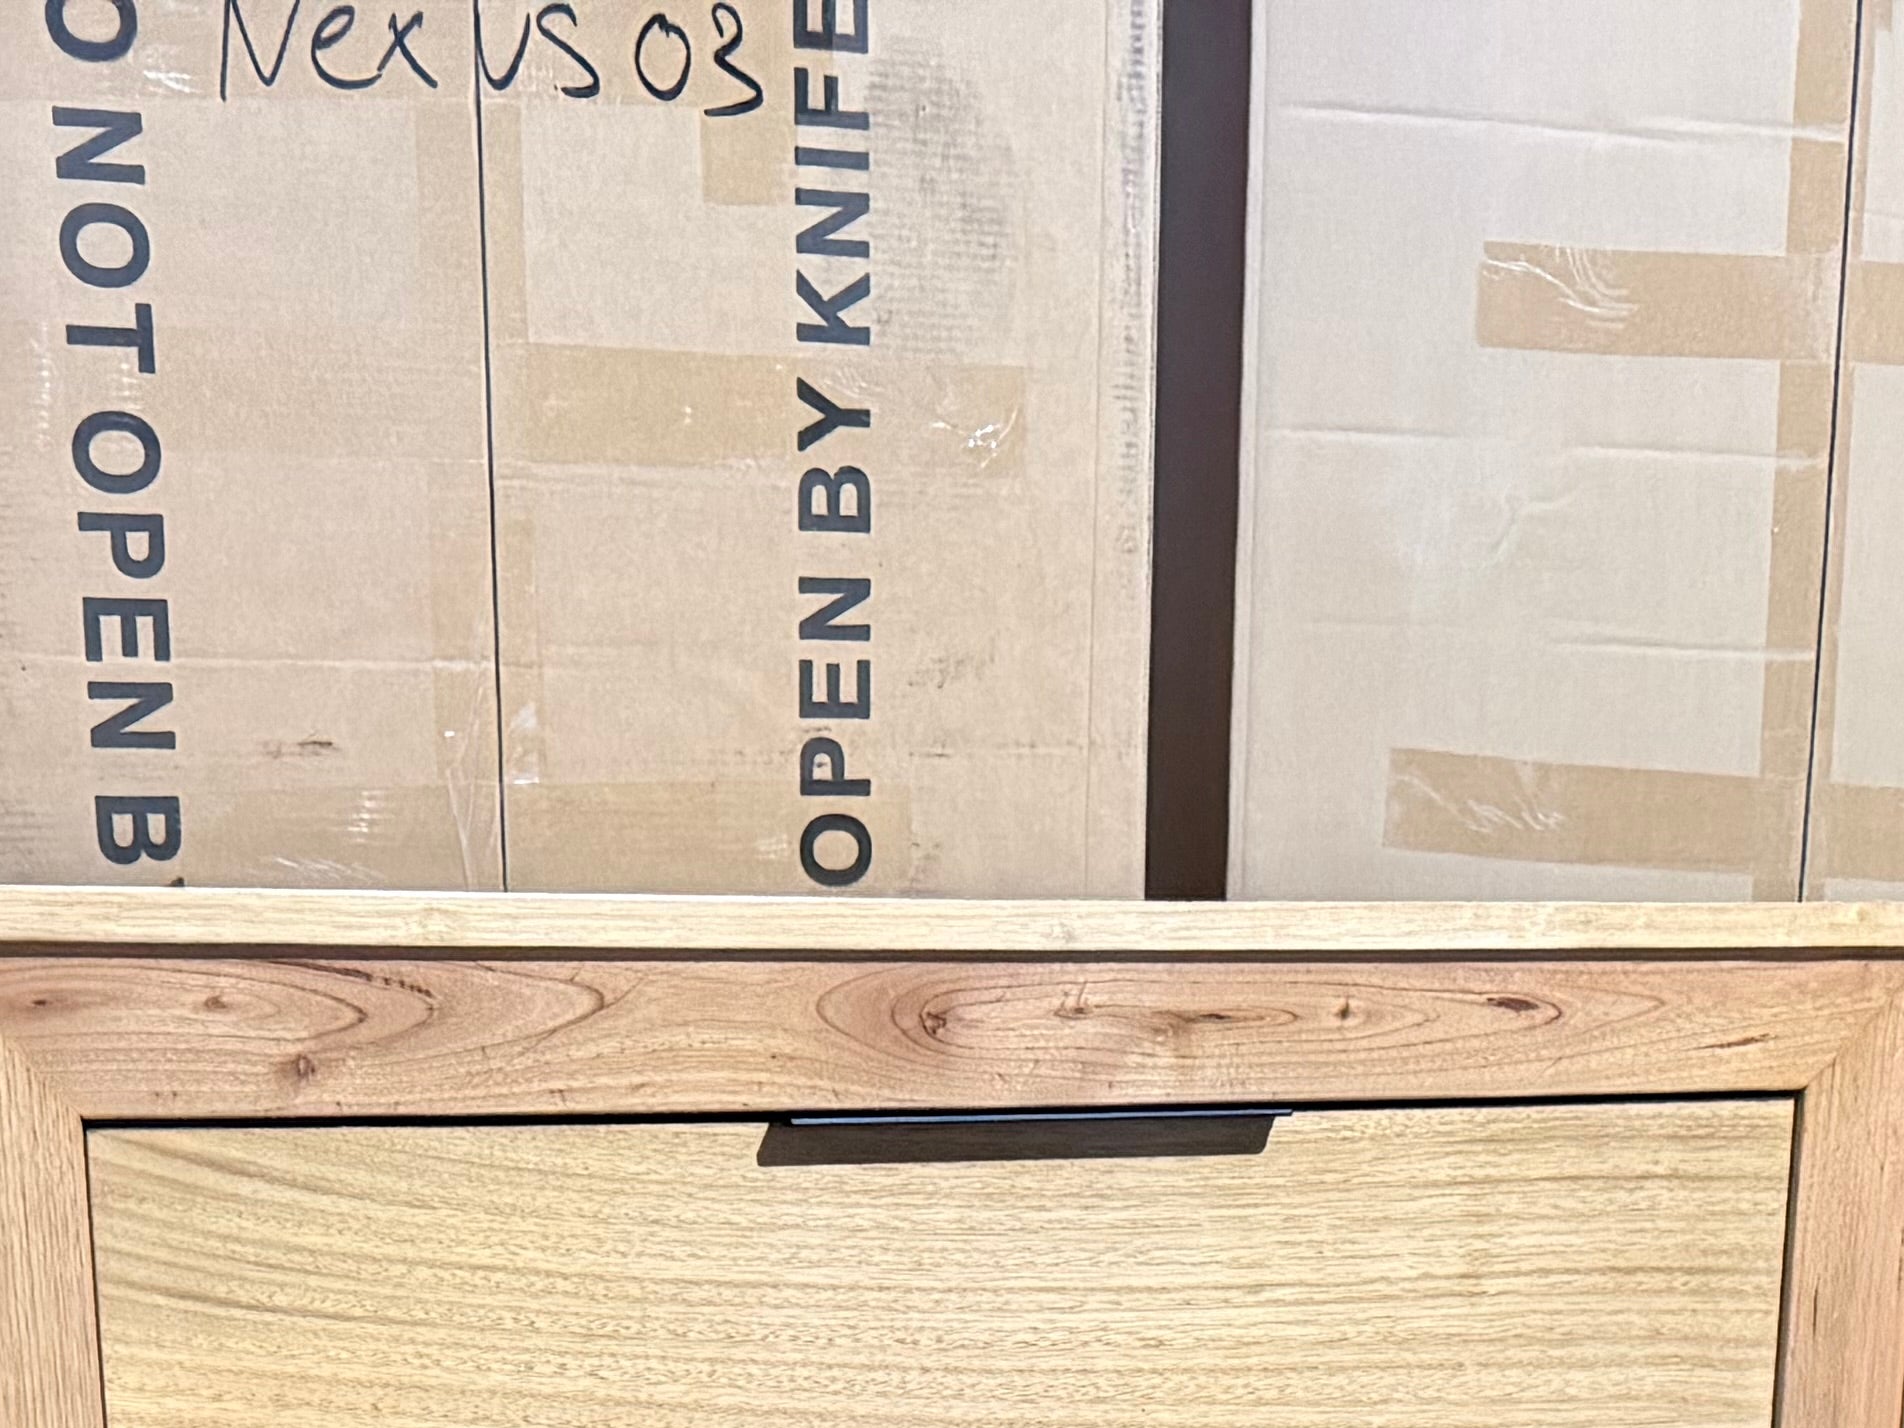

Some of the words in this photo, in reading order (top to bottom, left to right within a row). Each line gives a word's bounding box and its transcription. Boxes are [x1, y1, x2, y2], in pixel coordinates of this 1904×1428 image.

[634, 2, 764, 117] 03
[793, 0, 871, 347] KNIFE
[52, 105, 156, 374] NOT
[71, 410, 177, 750] OPEN
[797, 376, 872, 534] BY
[94, 795, 185, 887] B
[797, 574, 874, 888] OPEN
